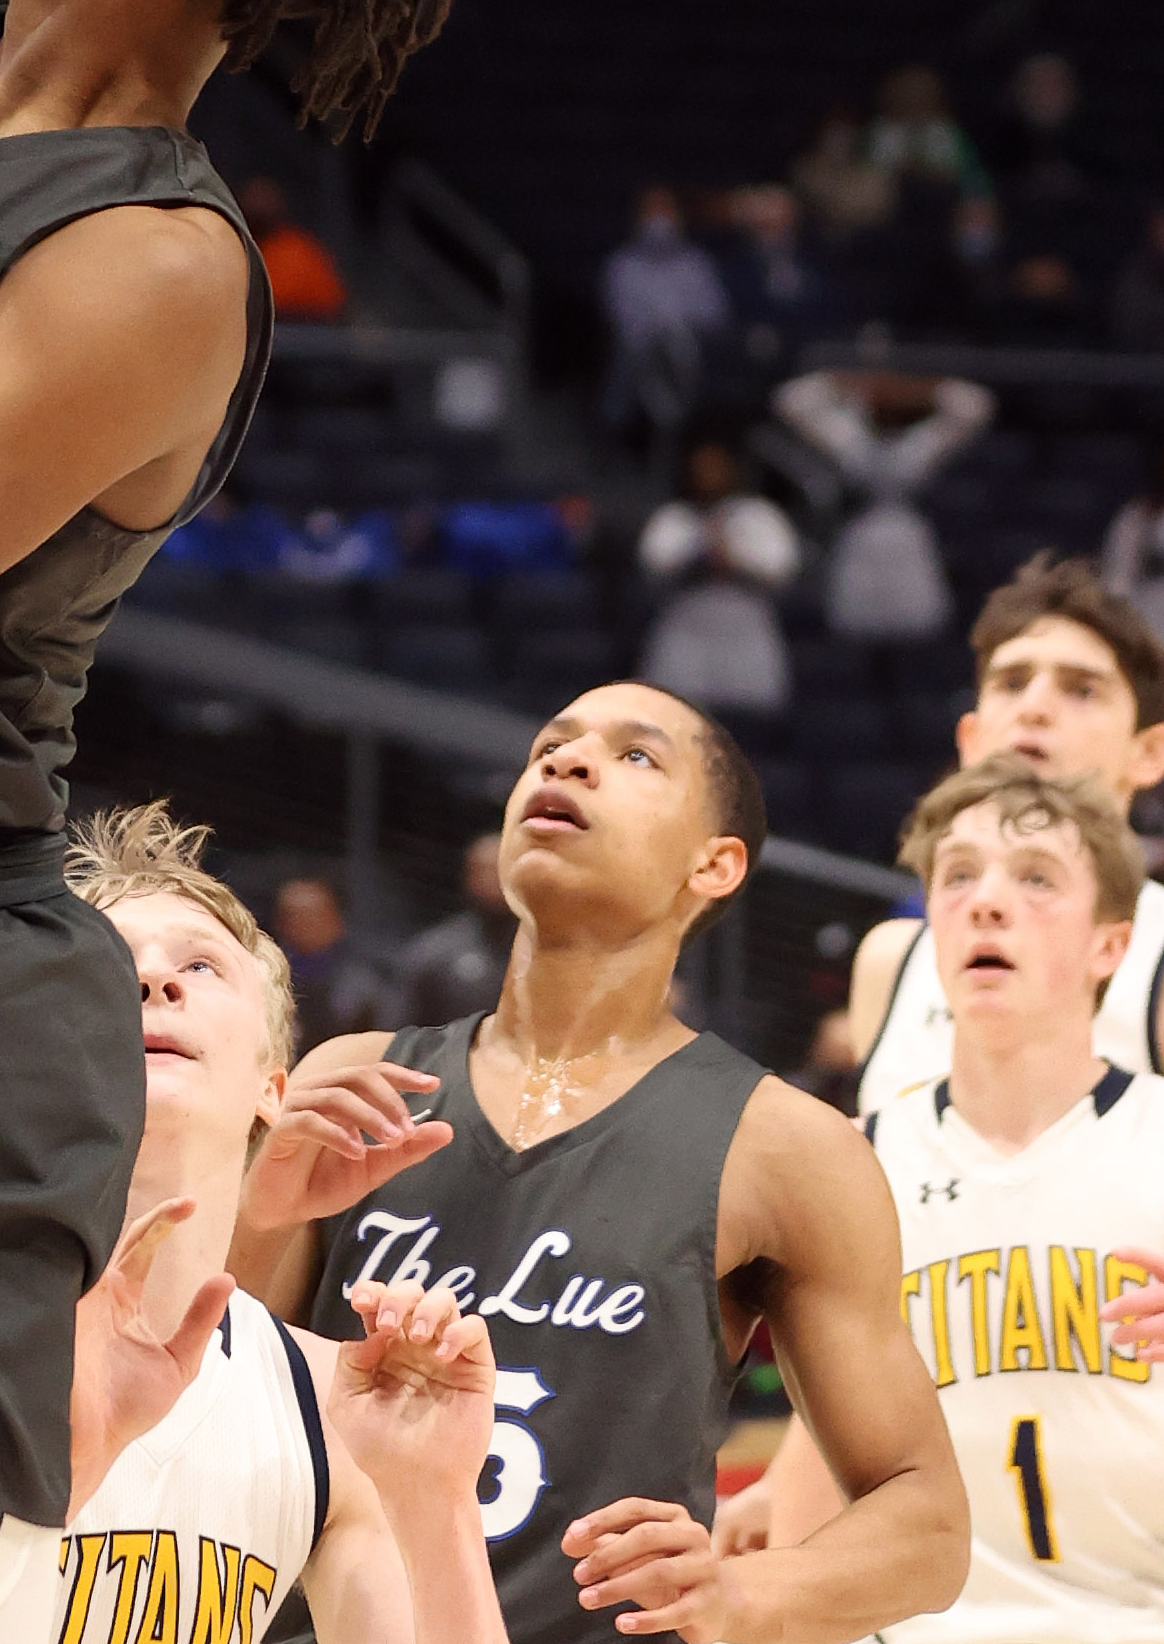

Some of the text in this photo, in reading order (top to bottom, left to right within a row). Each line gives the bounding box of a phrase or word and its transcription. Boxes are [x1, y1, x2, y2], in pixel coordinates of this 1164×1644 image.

[342, 1210, 647, 1336] The Lue
[1006, 1414, 1061, 1563] 1
